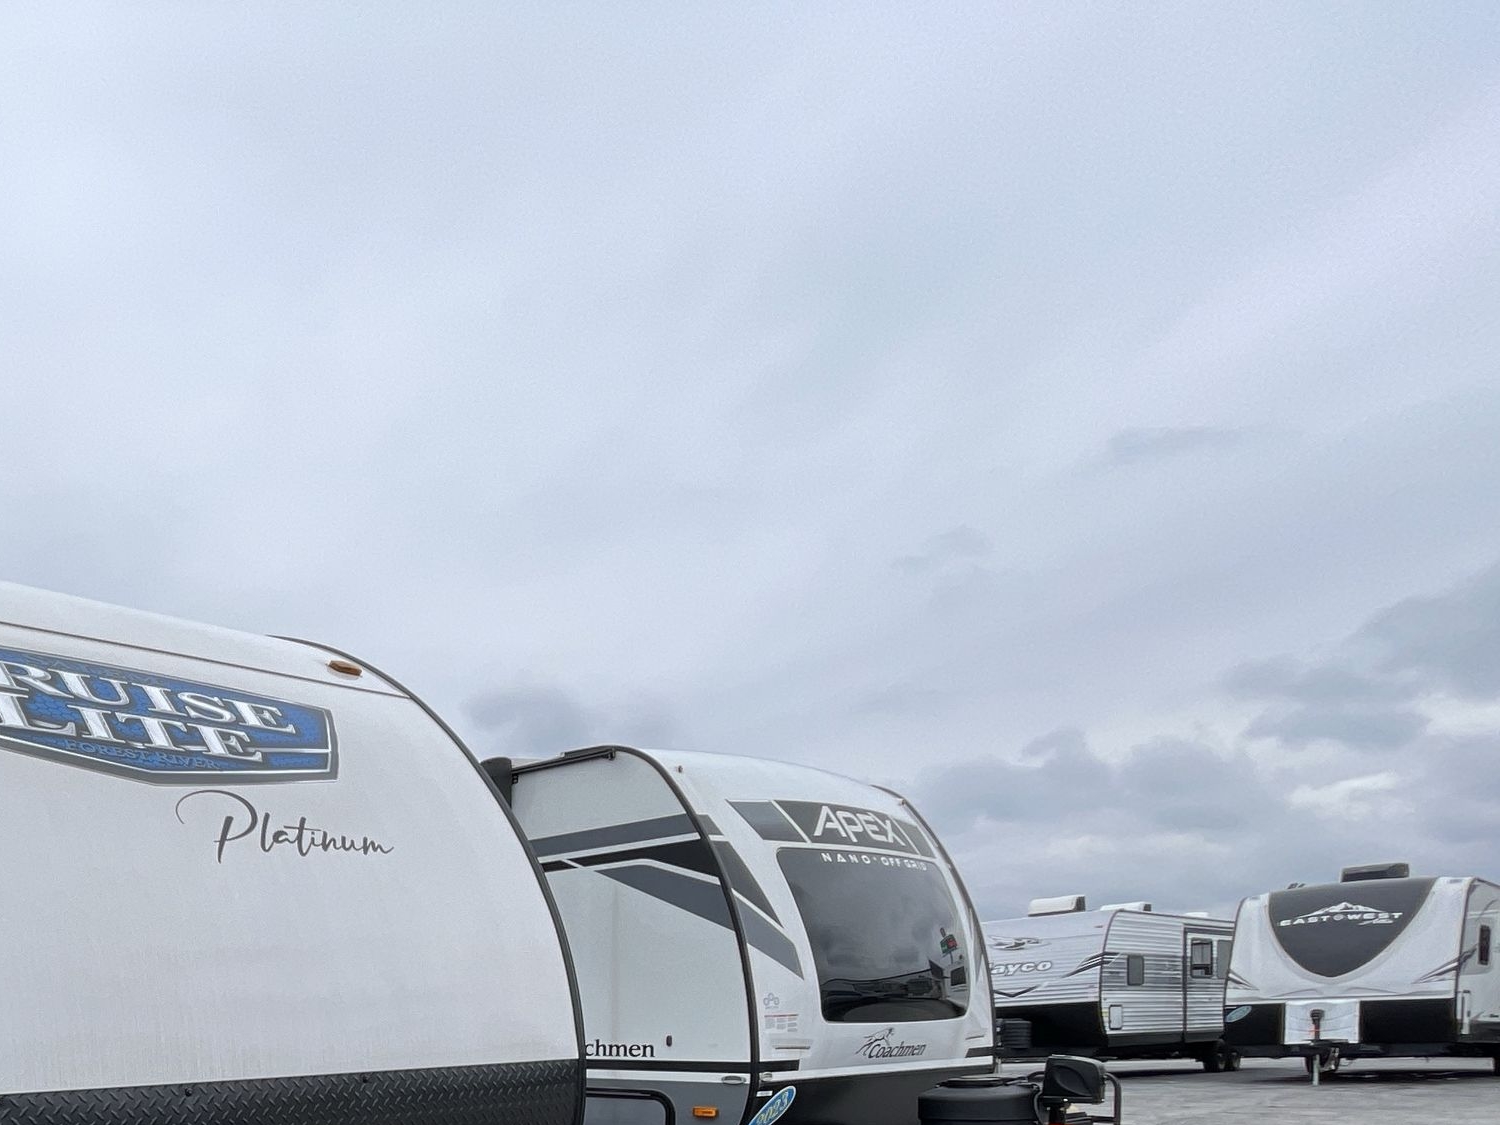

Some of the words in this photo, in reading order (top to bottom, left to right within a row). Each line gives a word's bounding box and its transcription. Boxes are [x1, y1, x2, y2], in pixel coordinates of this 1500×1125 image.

[175, 789, 394, 864] Platinum
[813, 805, 906, 846] APEX
[820, 852, 871, 865] NANO
[1277, 916, 1330, 926] EAST
[1347, 912, 1403, 920] WEST
[867, 1041, 927, 1059] Coachmen
